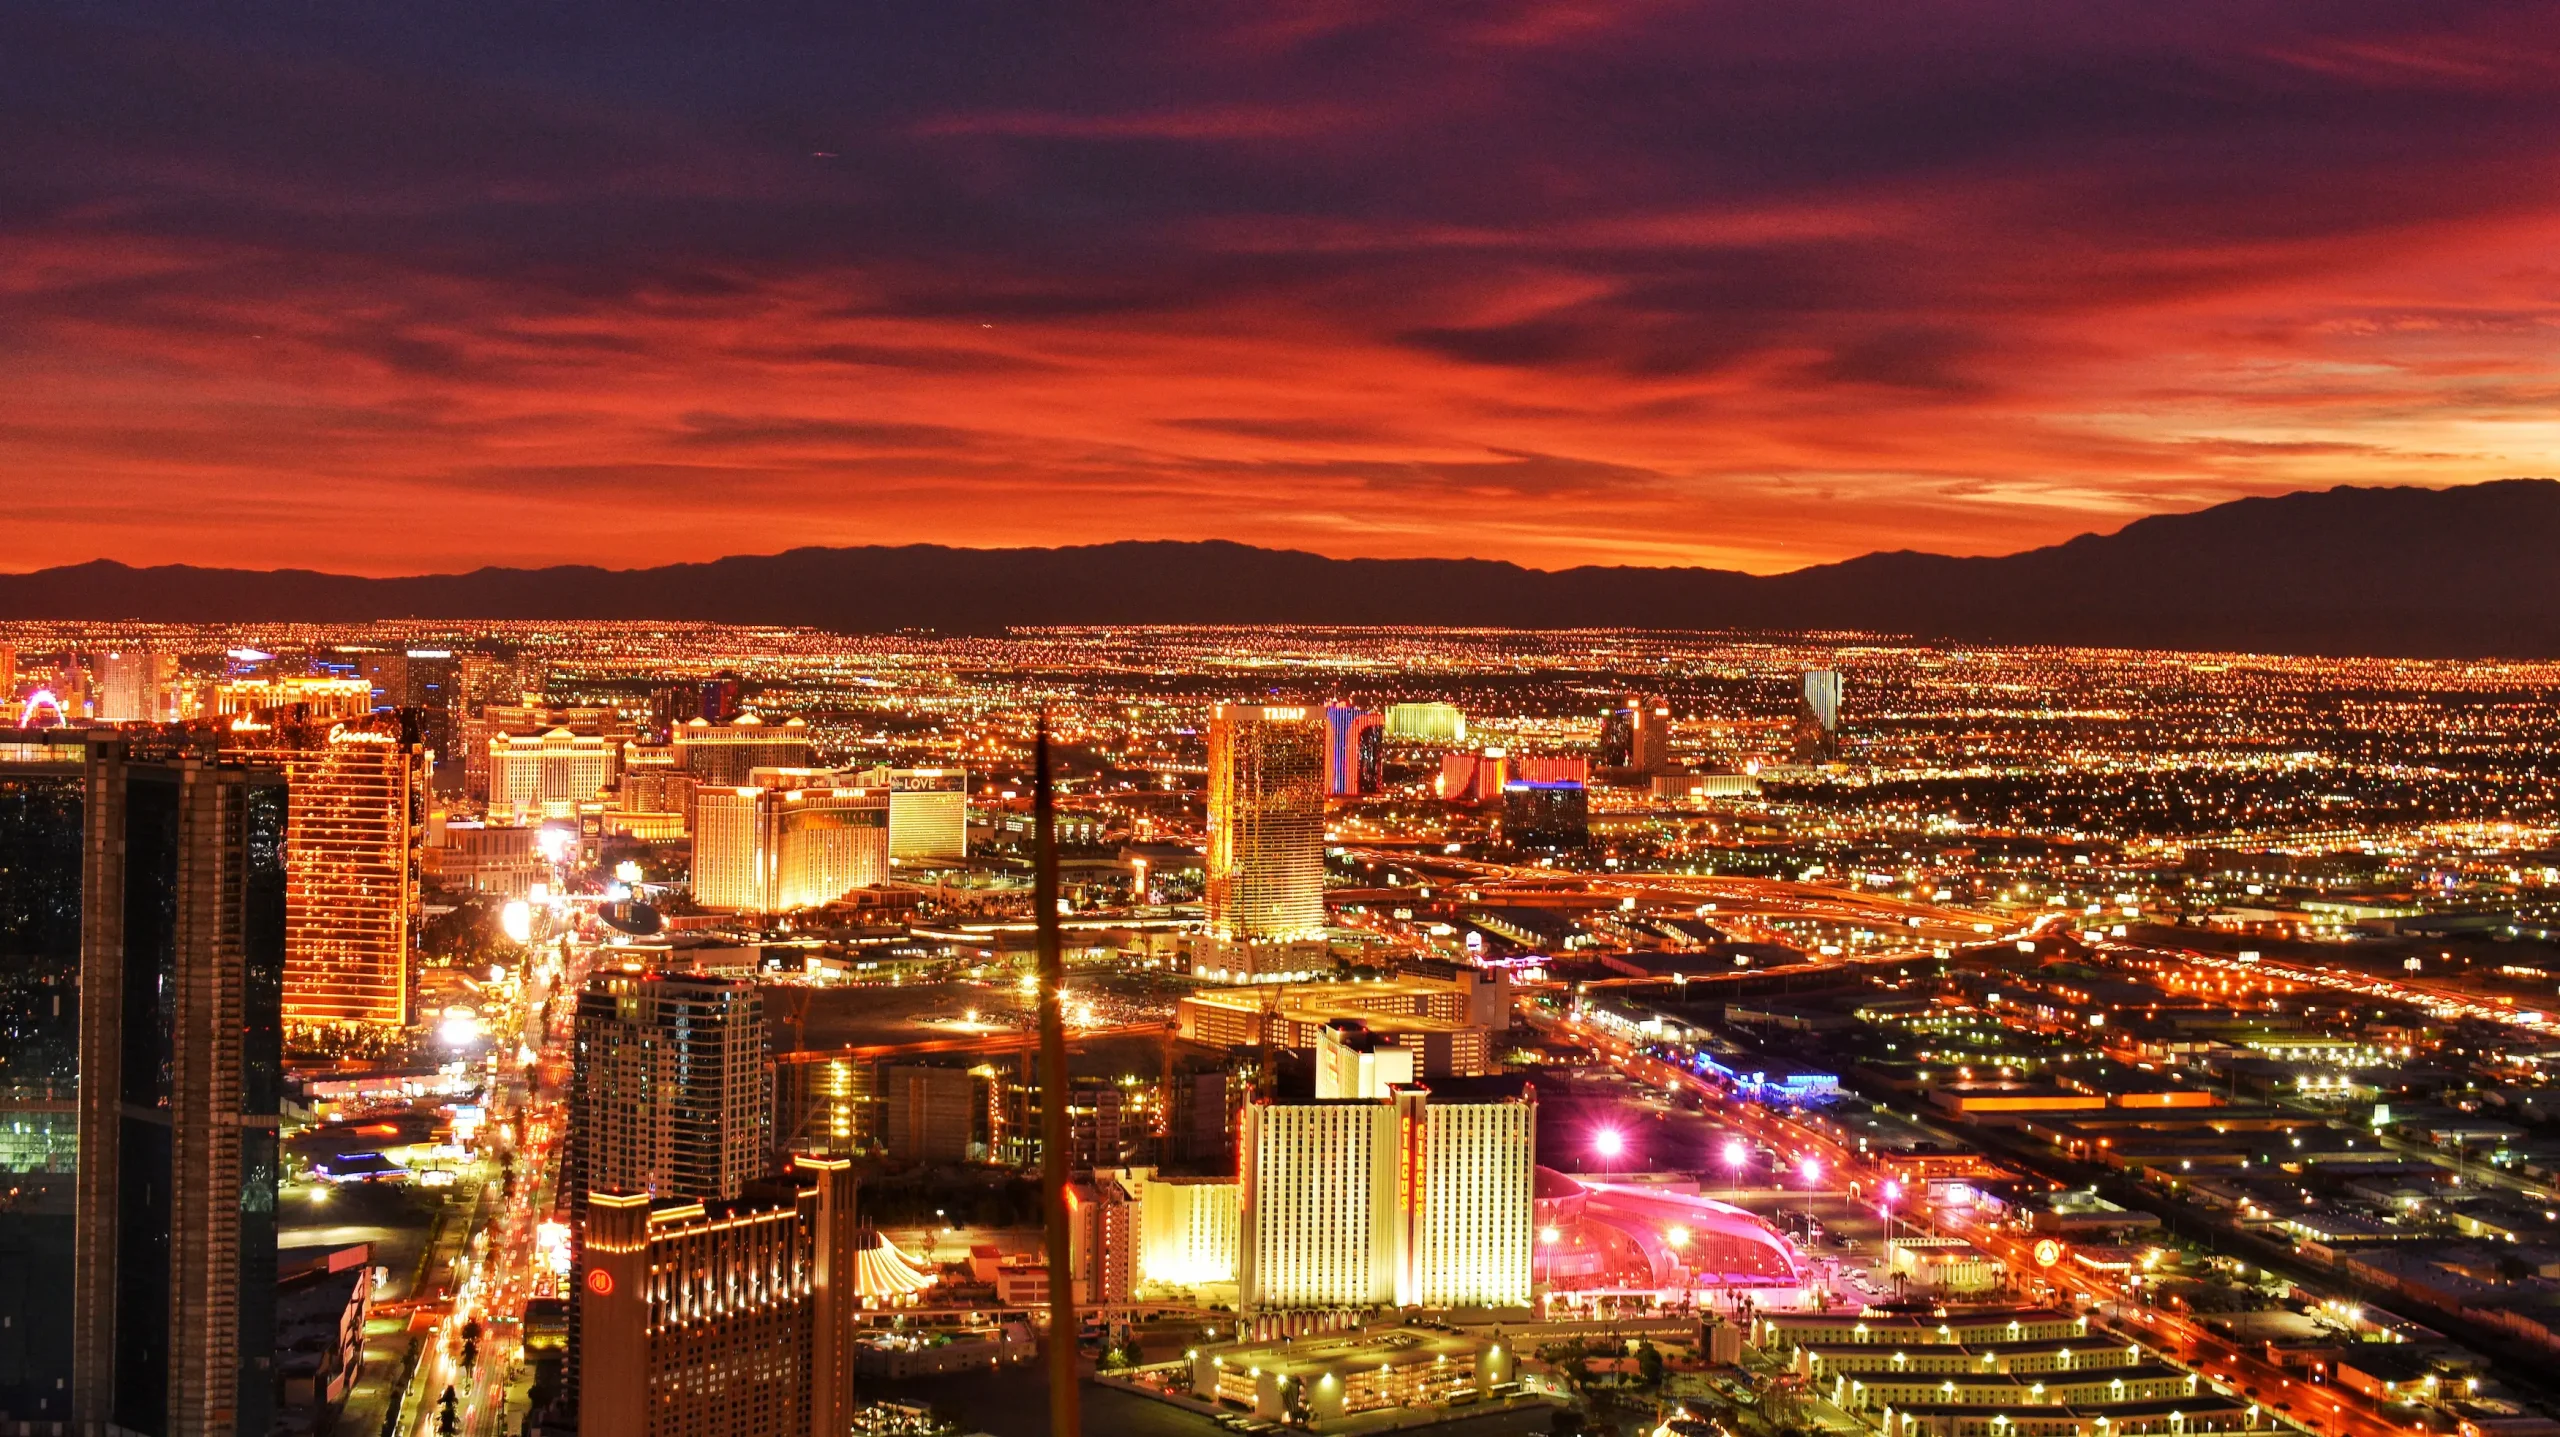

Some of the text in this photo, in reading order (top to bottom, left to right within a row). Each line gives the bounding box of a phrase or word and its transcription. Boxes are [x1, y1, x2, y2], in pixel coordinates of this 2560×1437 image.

[1263, 707, 1306, 719] TRUMP
[329, 723, 396, 743] Encore
[904, 778, 936, 790] LOVE
[1401, 1117, 1410, 1211] CIRCUS
[1416, 1123, 1425, 1217] CIRCUS
